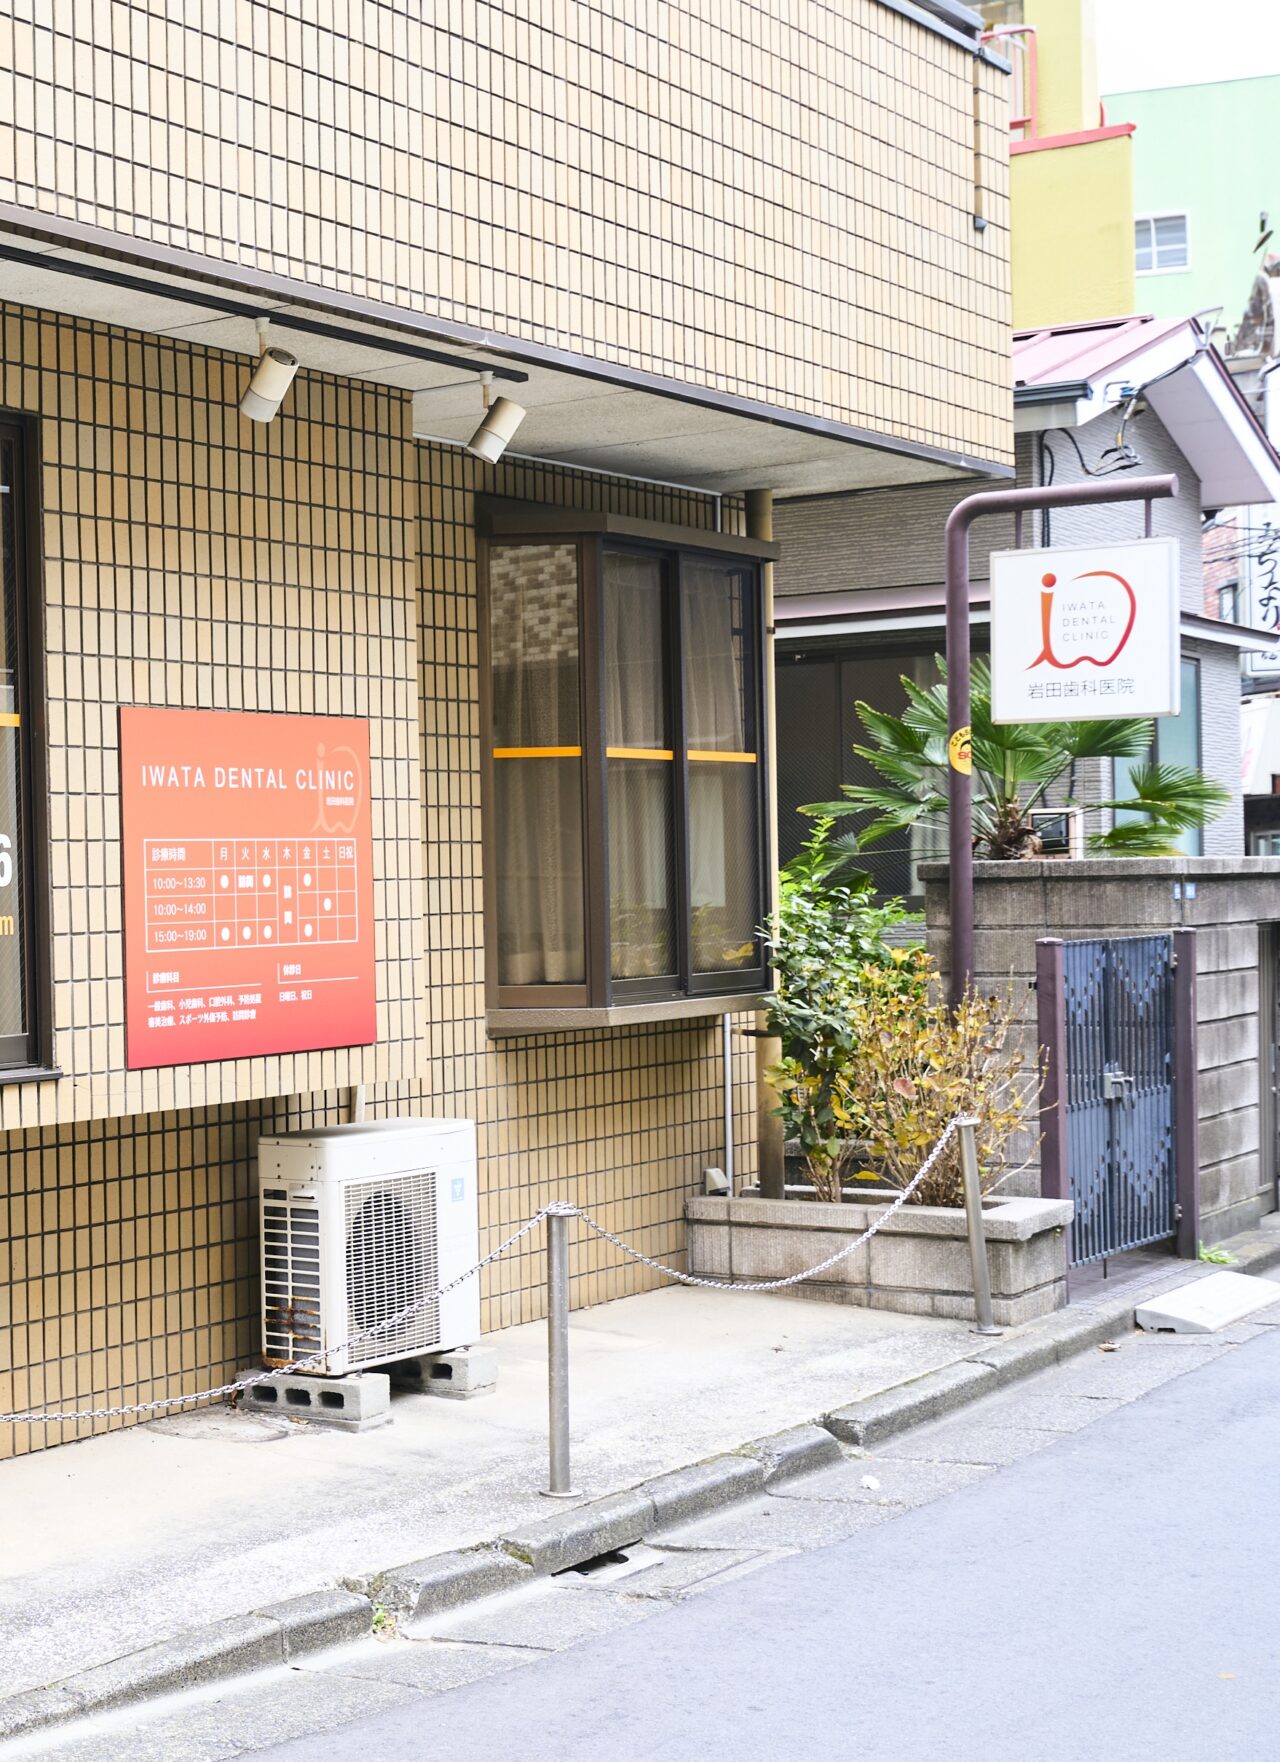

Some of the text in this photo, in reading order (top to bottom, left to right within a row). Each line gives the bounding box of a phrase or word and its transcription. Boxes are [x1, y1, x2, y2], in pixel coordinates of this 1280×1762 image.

[1062, 600, 1105, 612] IWATA
[1062, 615, 1116, 627] DENTAL
[1062, 630, 1109, 642] CLINIC
[1028, 678, 1135, 699] 岩田歯科医院
[141, 765, 355, 791] IWATA DENTAL CLINIC
[220, 847, 228, 861] 月
